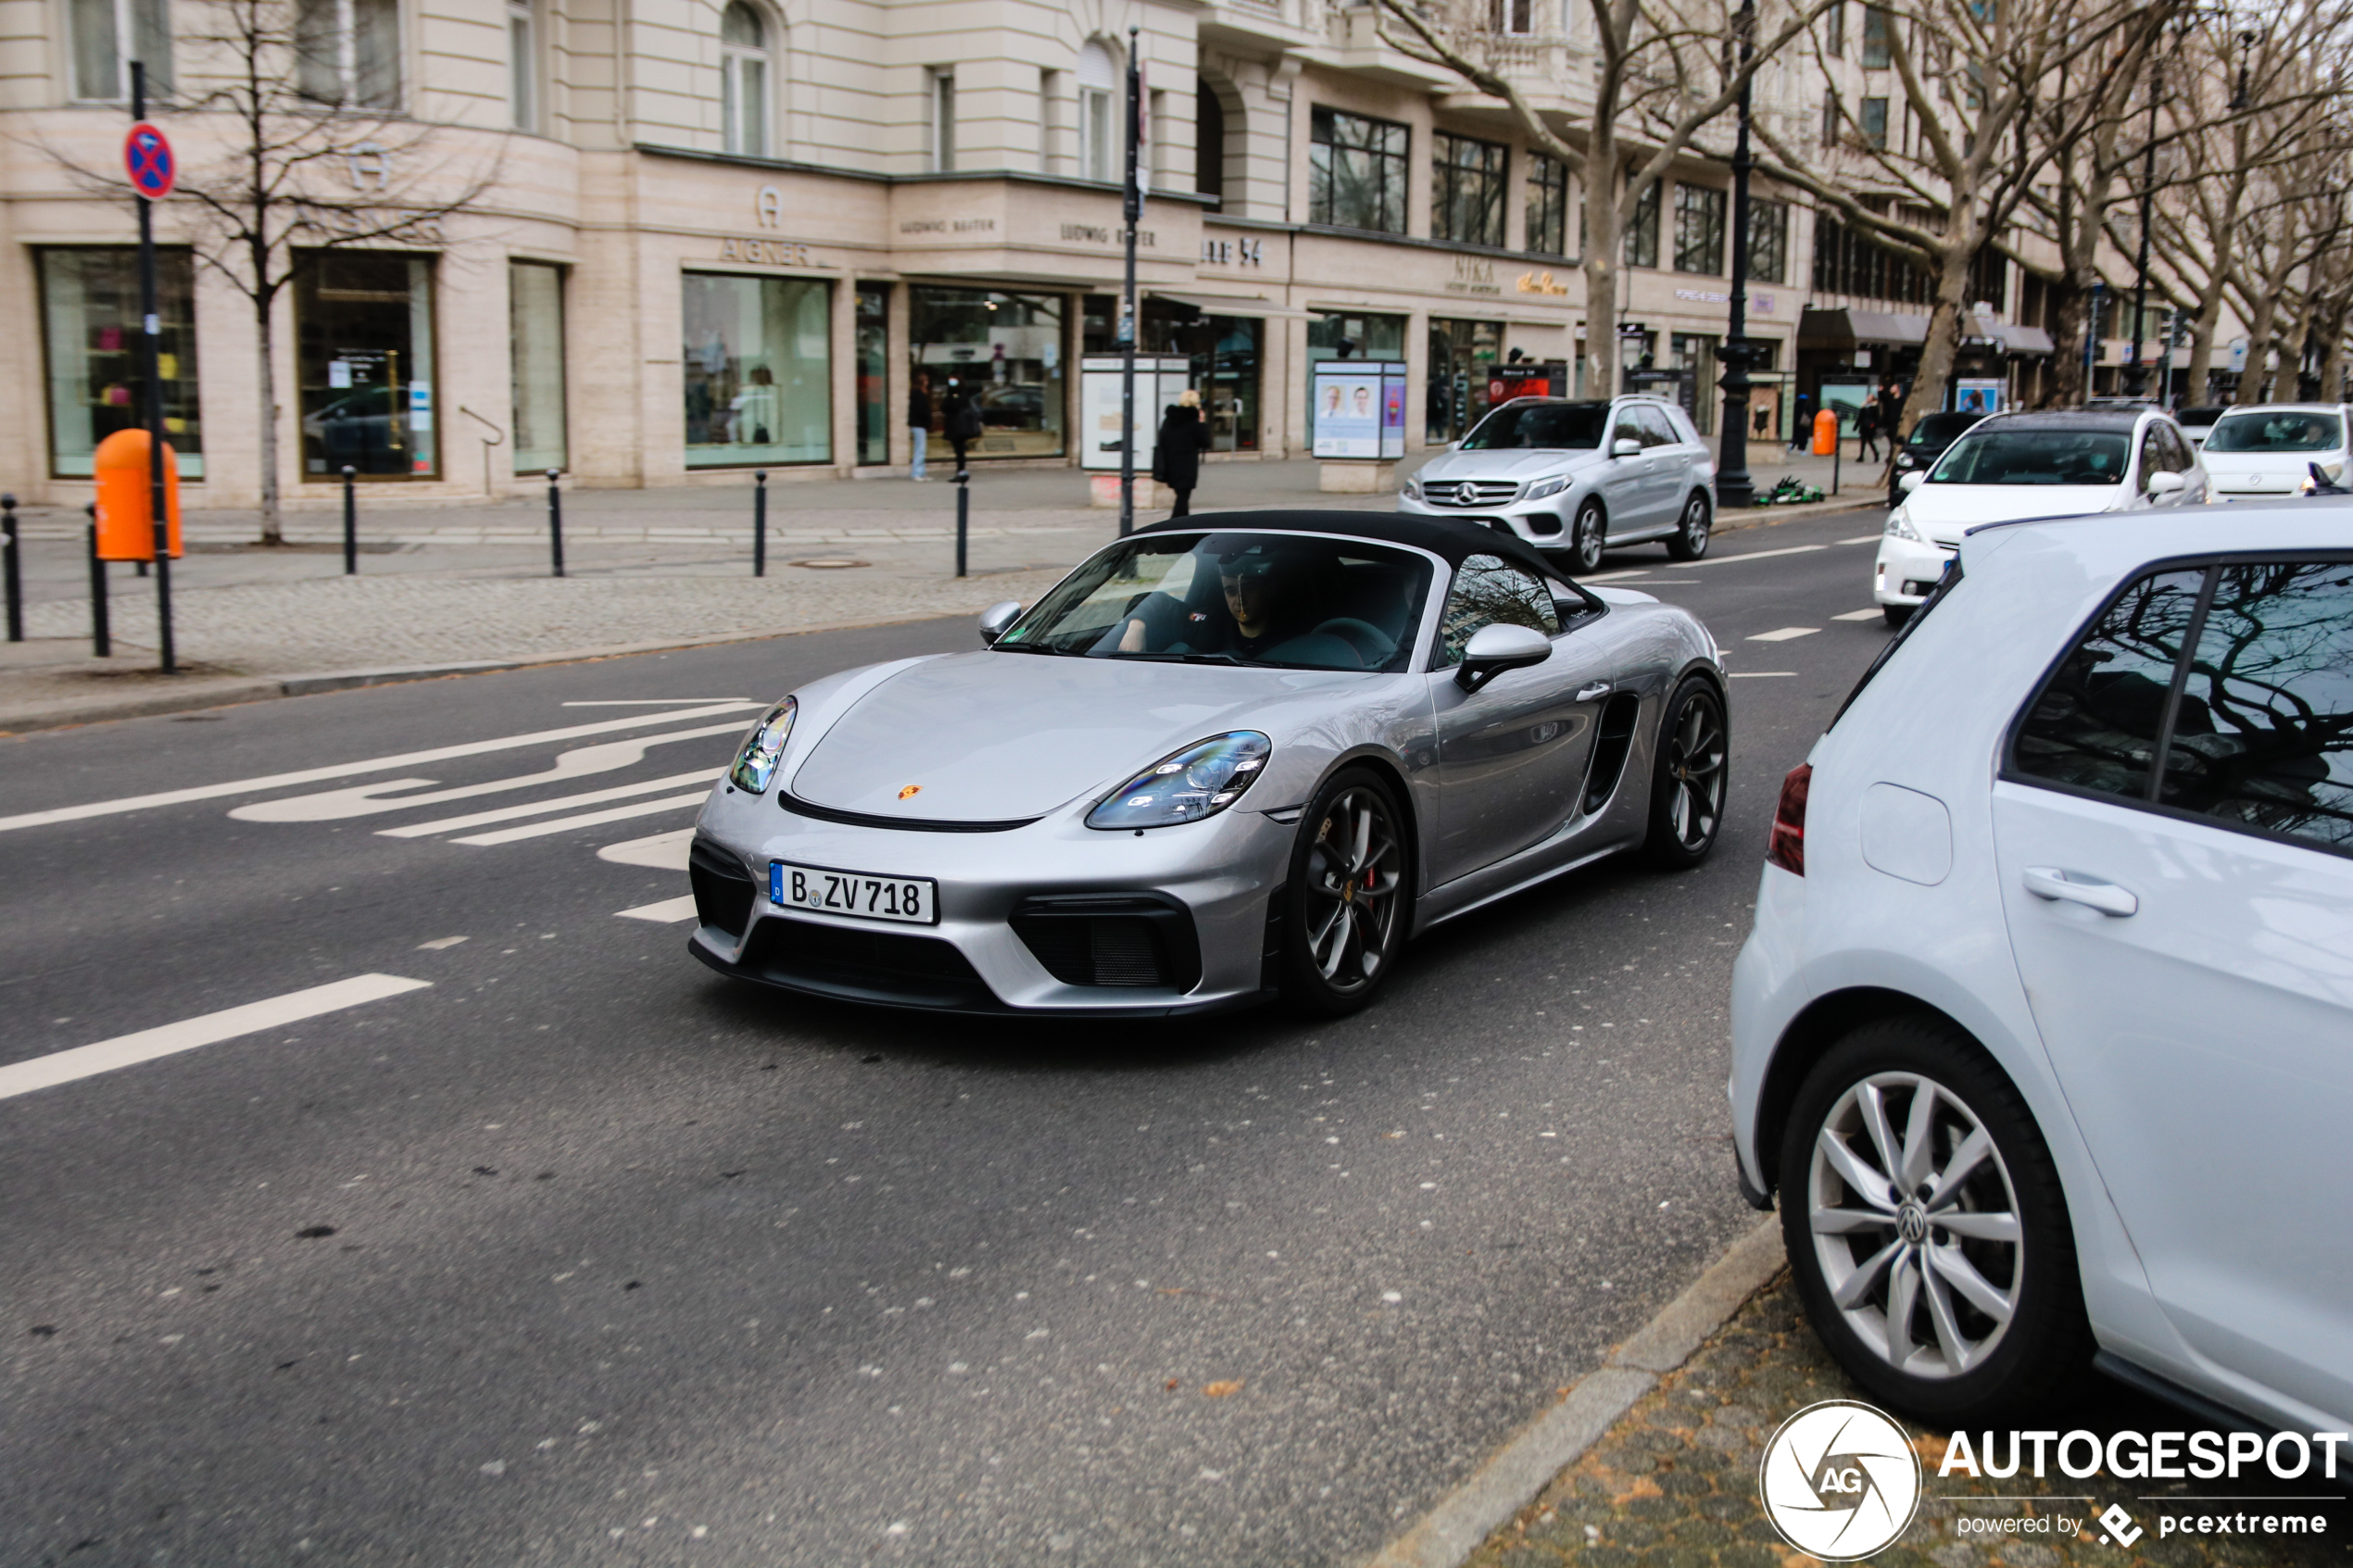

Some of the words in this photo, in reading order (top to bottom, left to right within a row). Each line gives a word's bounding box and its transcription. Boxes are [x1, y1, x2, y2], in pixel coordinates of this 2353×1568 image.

[1061, 223, 1109, 244] LUDWIG
[719, 238, 808, 267] AIGNER
[1240, 237, 1263, 267] 54
[774, 886, 781, 897] D
[792, 871, 808, 903] B
[824, 875, 859, 909] ZV
[865, 880, 920, 916] 718
